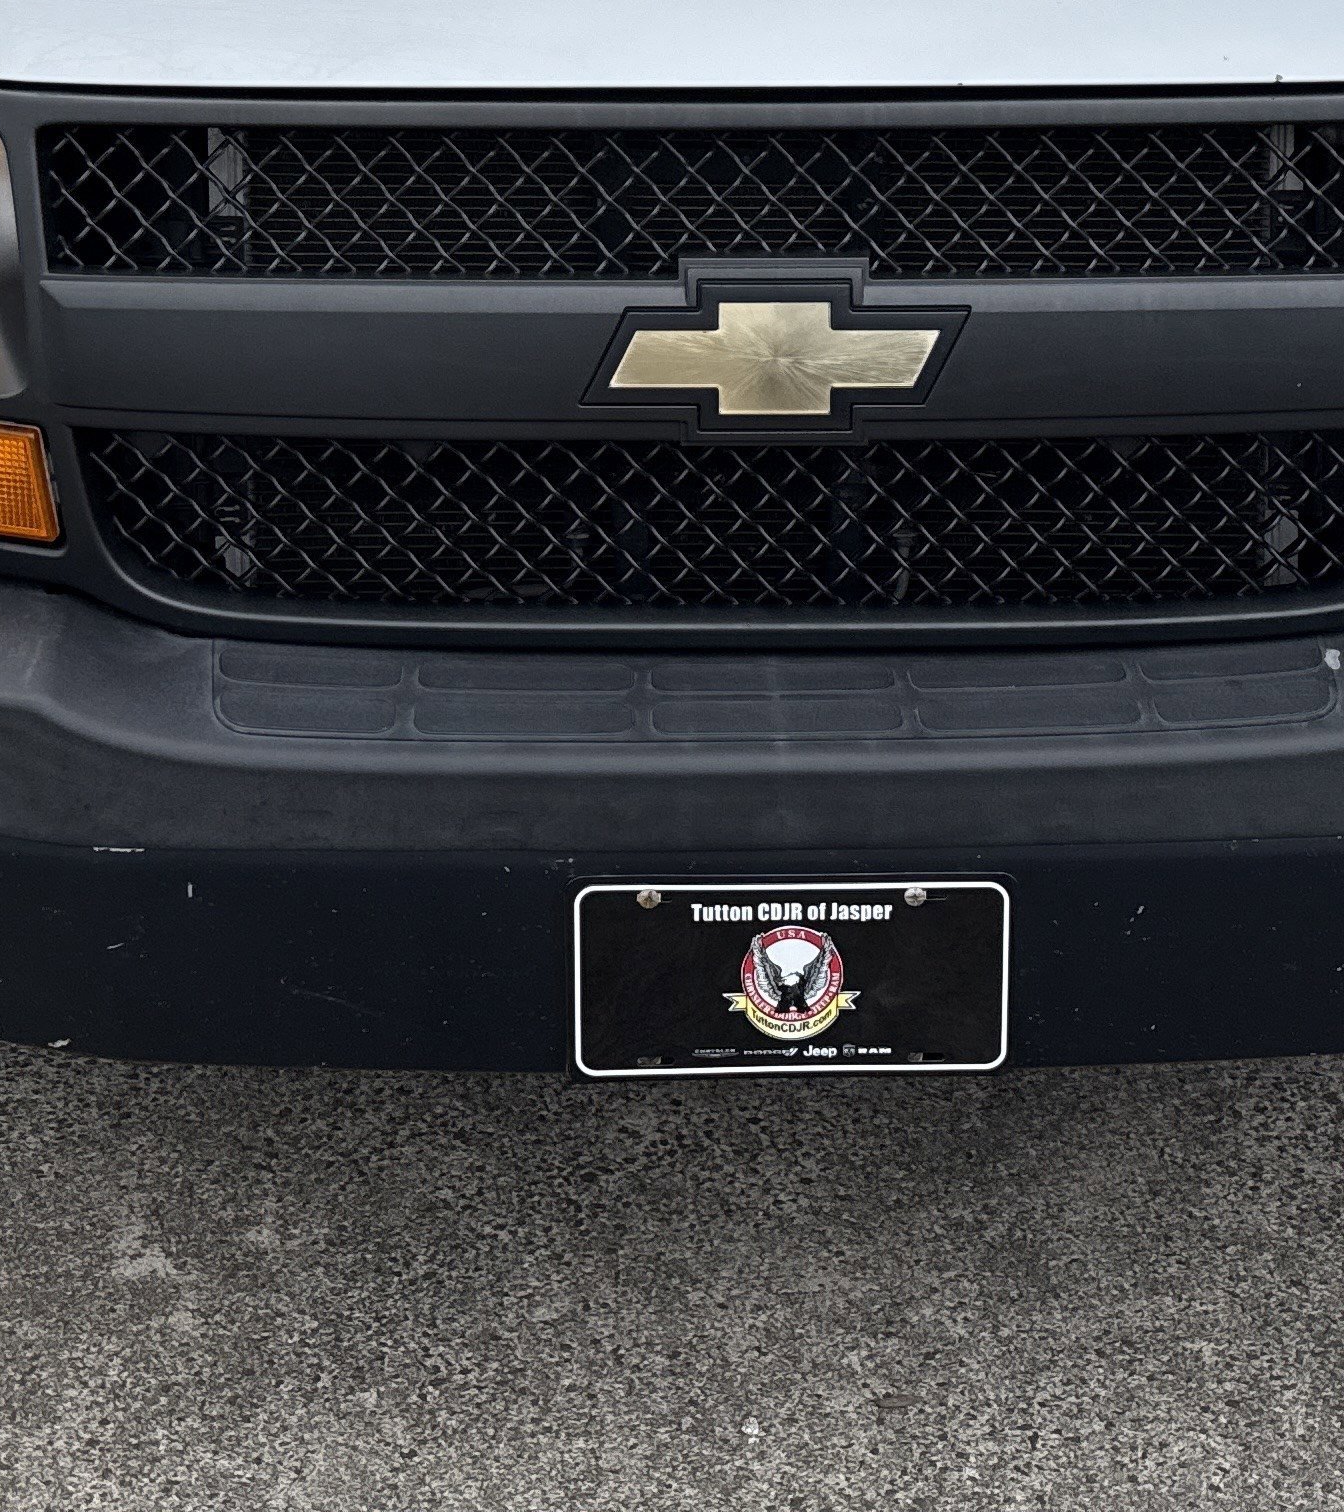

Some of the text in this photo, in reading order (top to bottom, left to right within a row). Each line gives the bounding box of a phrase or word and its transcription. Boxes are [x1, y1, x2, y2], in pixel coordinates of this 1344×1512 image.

[691, 902, 893, 921] Tutton CDJR of Jasper
[776, 929, 806, 939] USA
[751, 1007, 833, 1033] TuttonCDJR.com
[803, 1044, 838, 1058] Jeep
[857, 1047, 892, 1055] RAM
